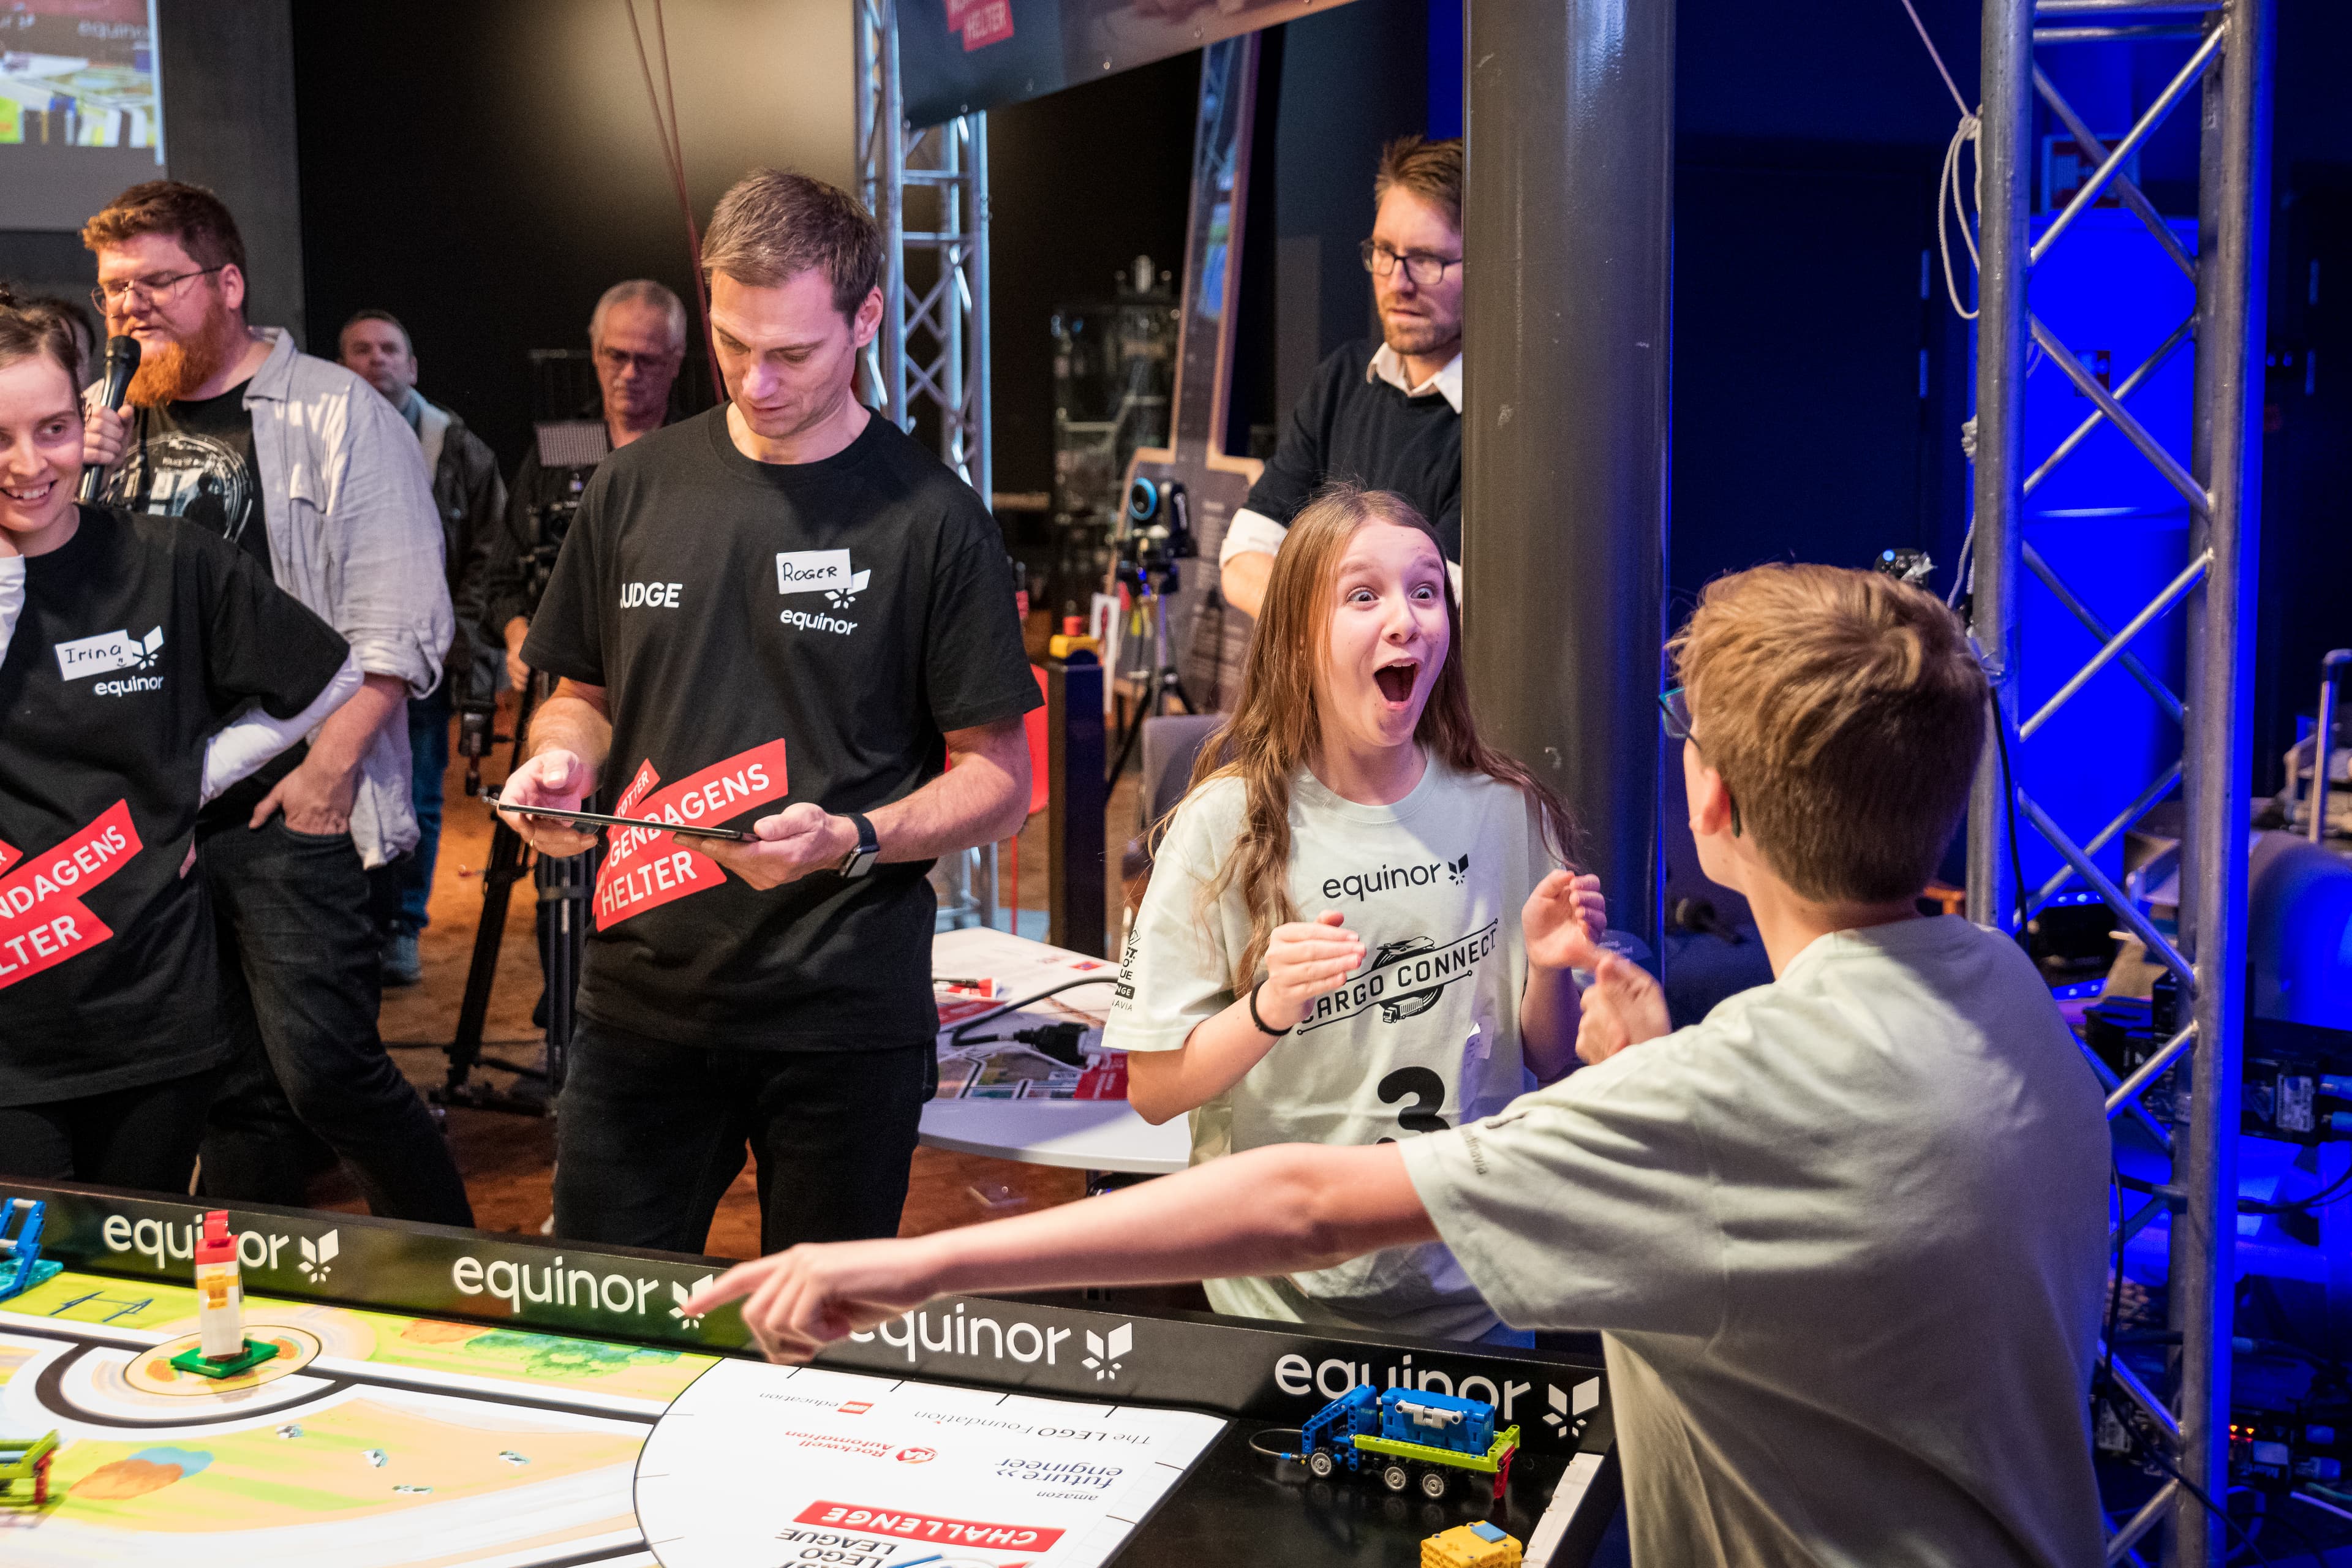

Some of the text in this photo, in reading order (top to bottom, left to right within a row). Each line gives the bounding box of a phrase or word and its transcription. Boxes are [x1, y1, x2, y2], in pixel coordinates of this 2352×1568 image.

[620, 582, 683, 609] UDGE
[780, 609, 858, 635] equinor
[64, 644, 122, 664] Irina
[94, 675, 164, 698] equinor
[601, 851, 698, 916] HELTER
[1322, 862, 1441, 902] equinor
[103, 1213, 290, 1269] equior
[453, 1256, 660, 1314] equinor
[760, 1393, 839, 1407] education
[785, 1430, 895, 1450] Automation
[914, 1410, 1152, 1445] The LEGO Foundation
[798, 1440, 886, 1457] Rockwell
[995, 1458, 1123, 1477] engineer
[1036, 1490, 1099, 1502] amazon
[820, 1507, 1039, 1546] CHALLENGE
[774, 1528, 899, 1555] LEAGUE
[799, 1548, 885, 1568] LEGO
